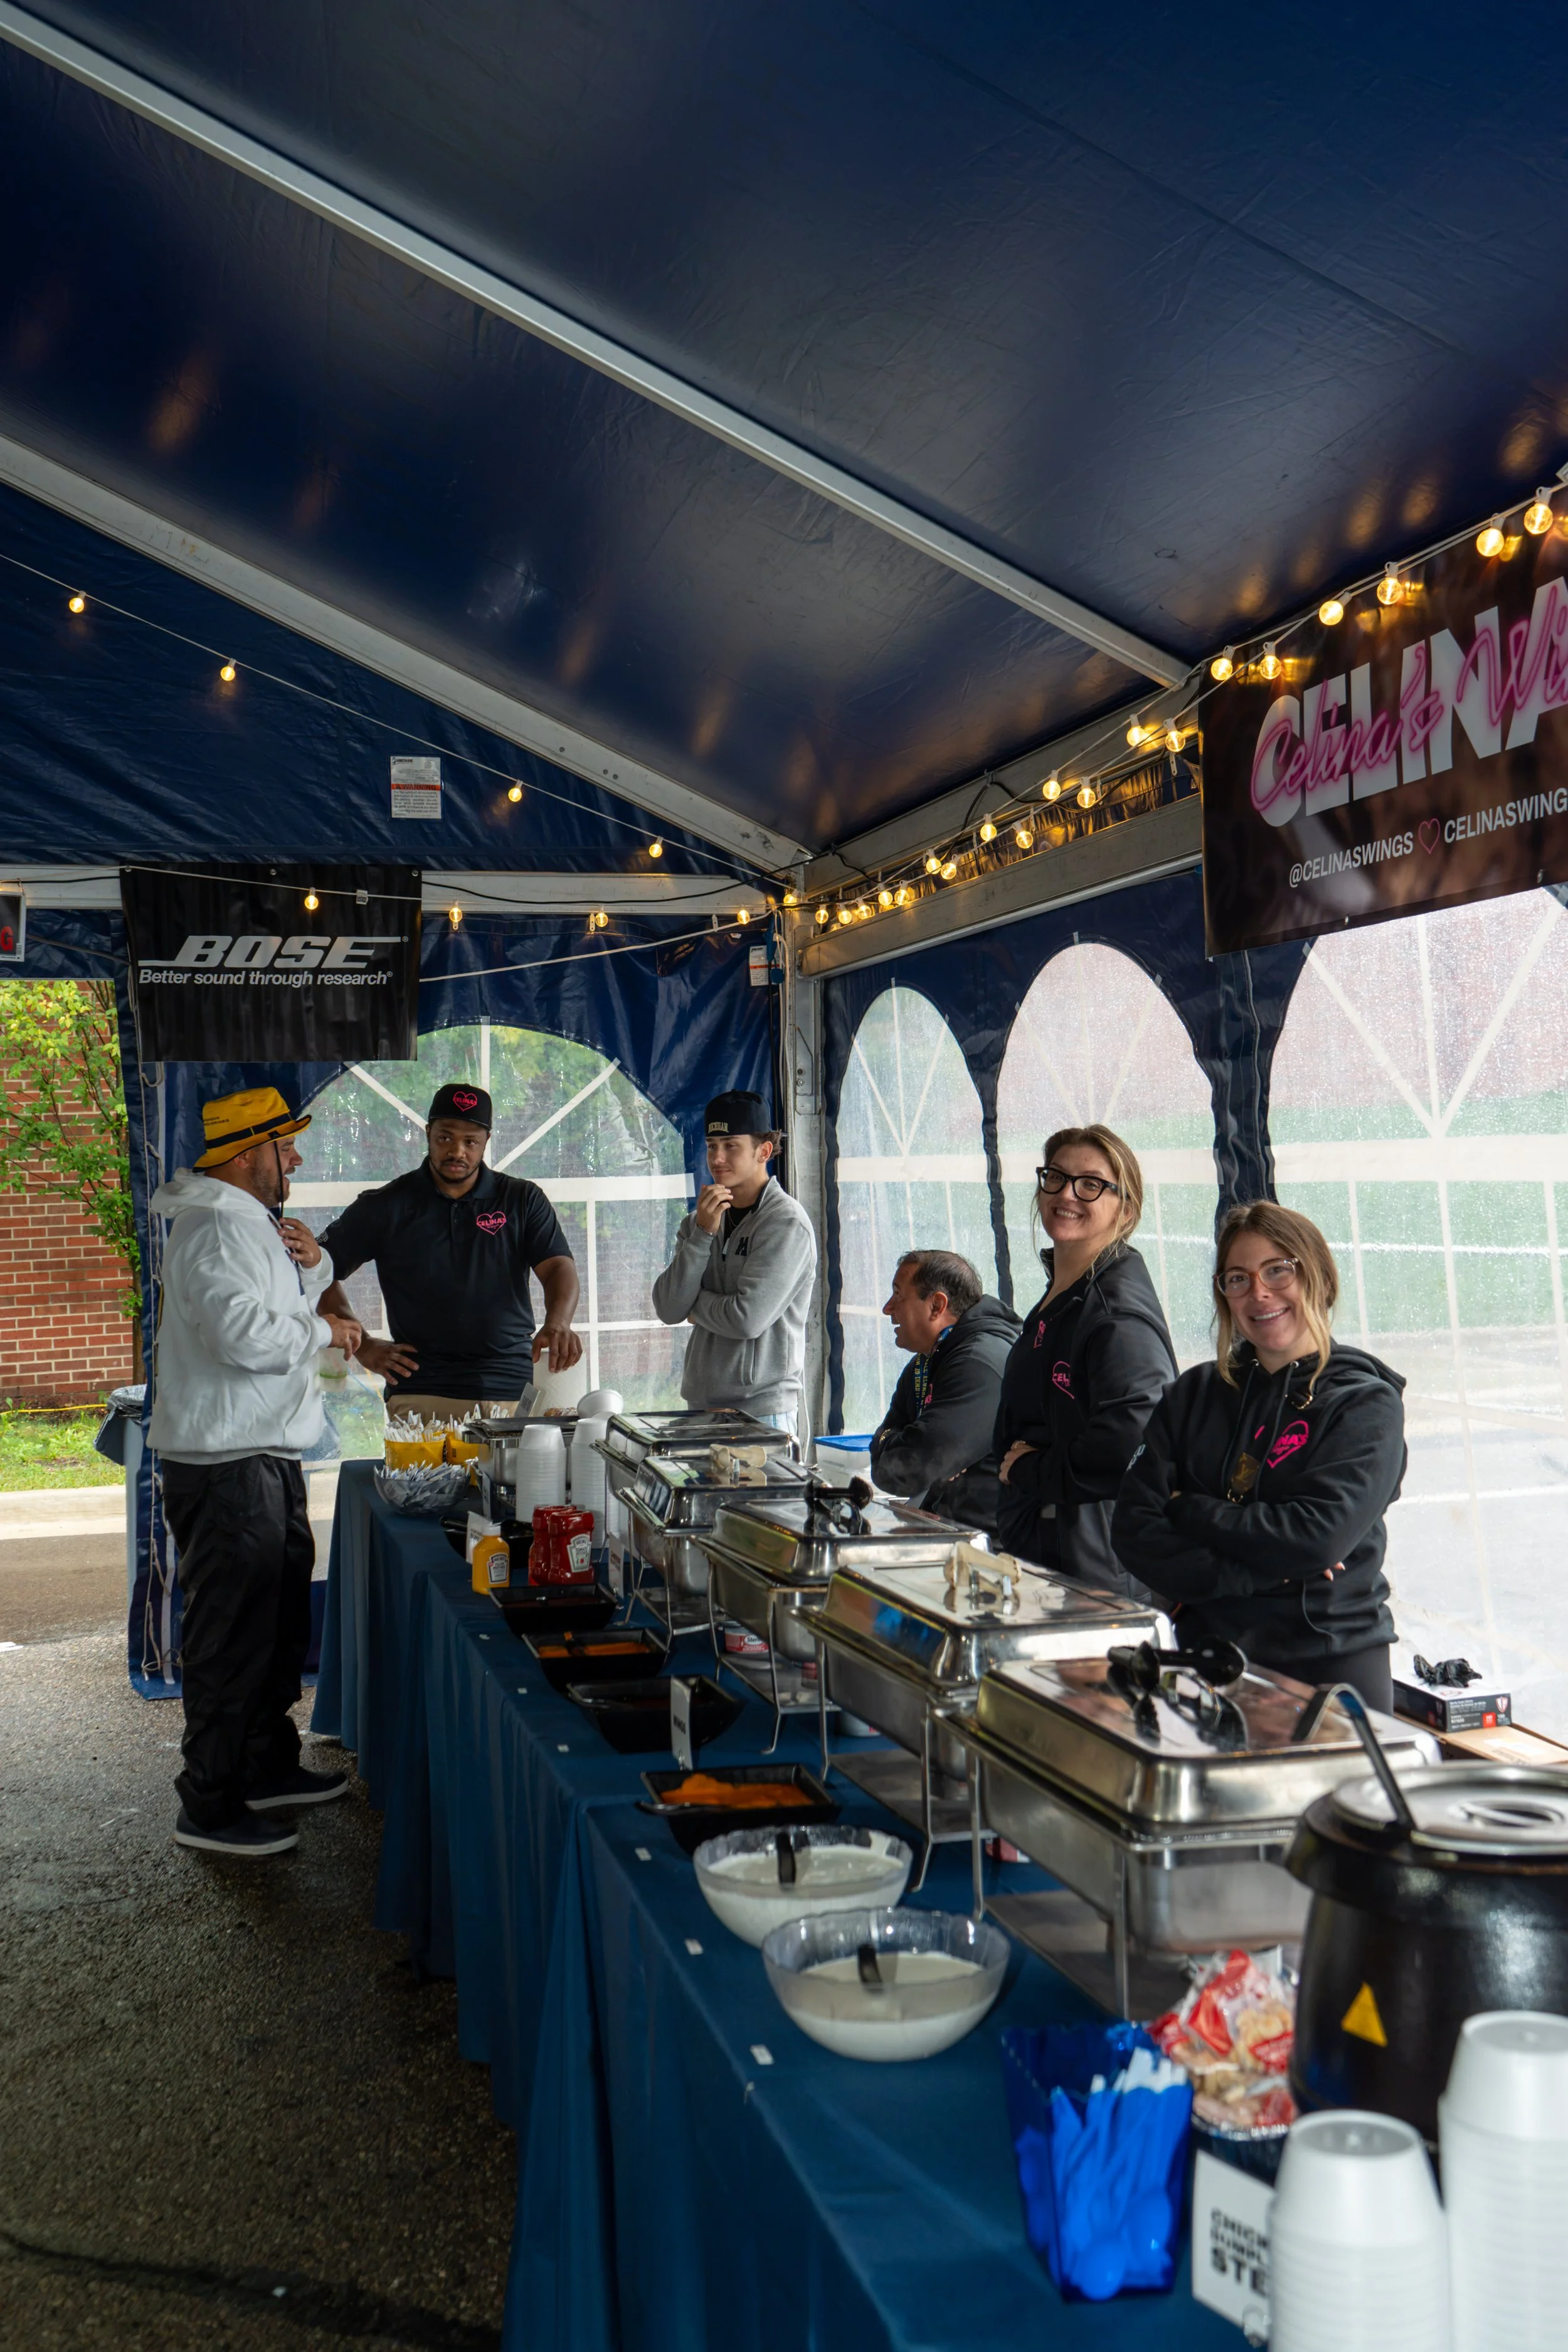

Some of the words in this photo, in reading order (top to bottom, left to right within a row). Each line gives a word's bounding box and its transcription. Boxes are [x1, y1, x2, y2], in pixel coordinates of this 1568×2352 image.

[1290, 831, 1414, 887] @CELINASWINGS
[1444, 787, 1568, 844] CELINASWING
[139, 969, 191, 983] Better
[194, 971, 245, 985] sound
[249, 971, 312, 988] through
[1210, 2206, 1269, 2250] CHICK
[1210, 2227, 1264, 2265] DUMPL
[1211, 2244, 1268, 2299] STE
